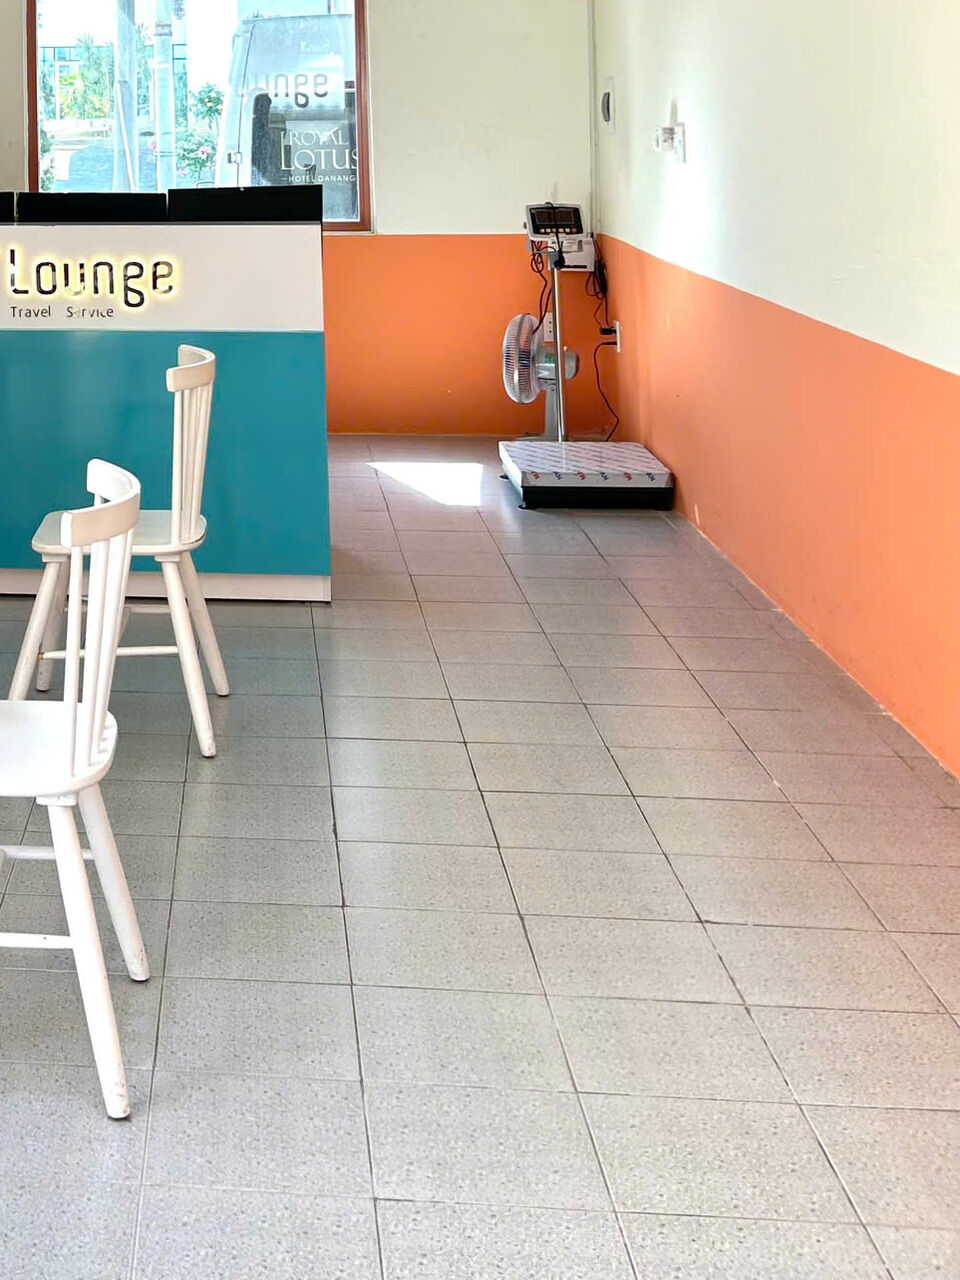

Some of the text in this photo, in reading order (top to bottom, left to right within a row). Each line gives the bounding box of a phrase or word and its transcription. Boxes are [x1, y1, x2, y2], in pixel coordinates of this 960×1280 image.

[288, 128, 349, 146] ROYAL
[9, 249, 174, 308] Lounge
[10, 305, 51, 318] Travel
